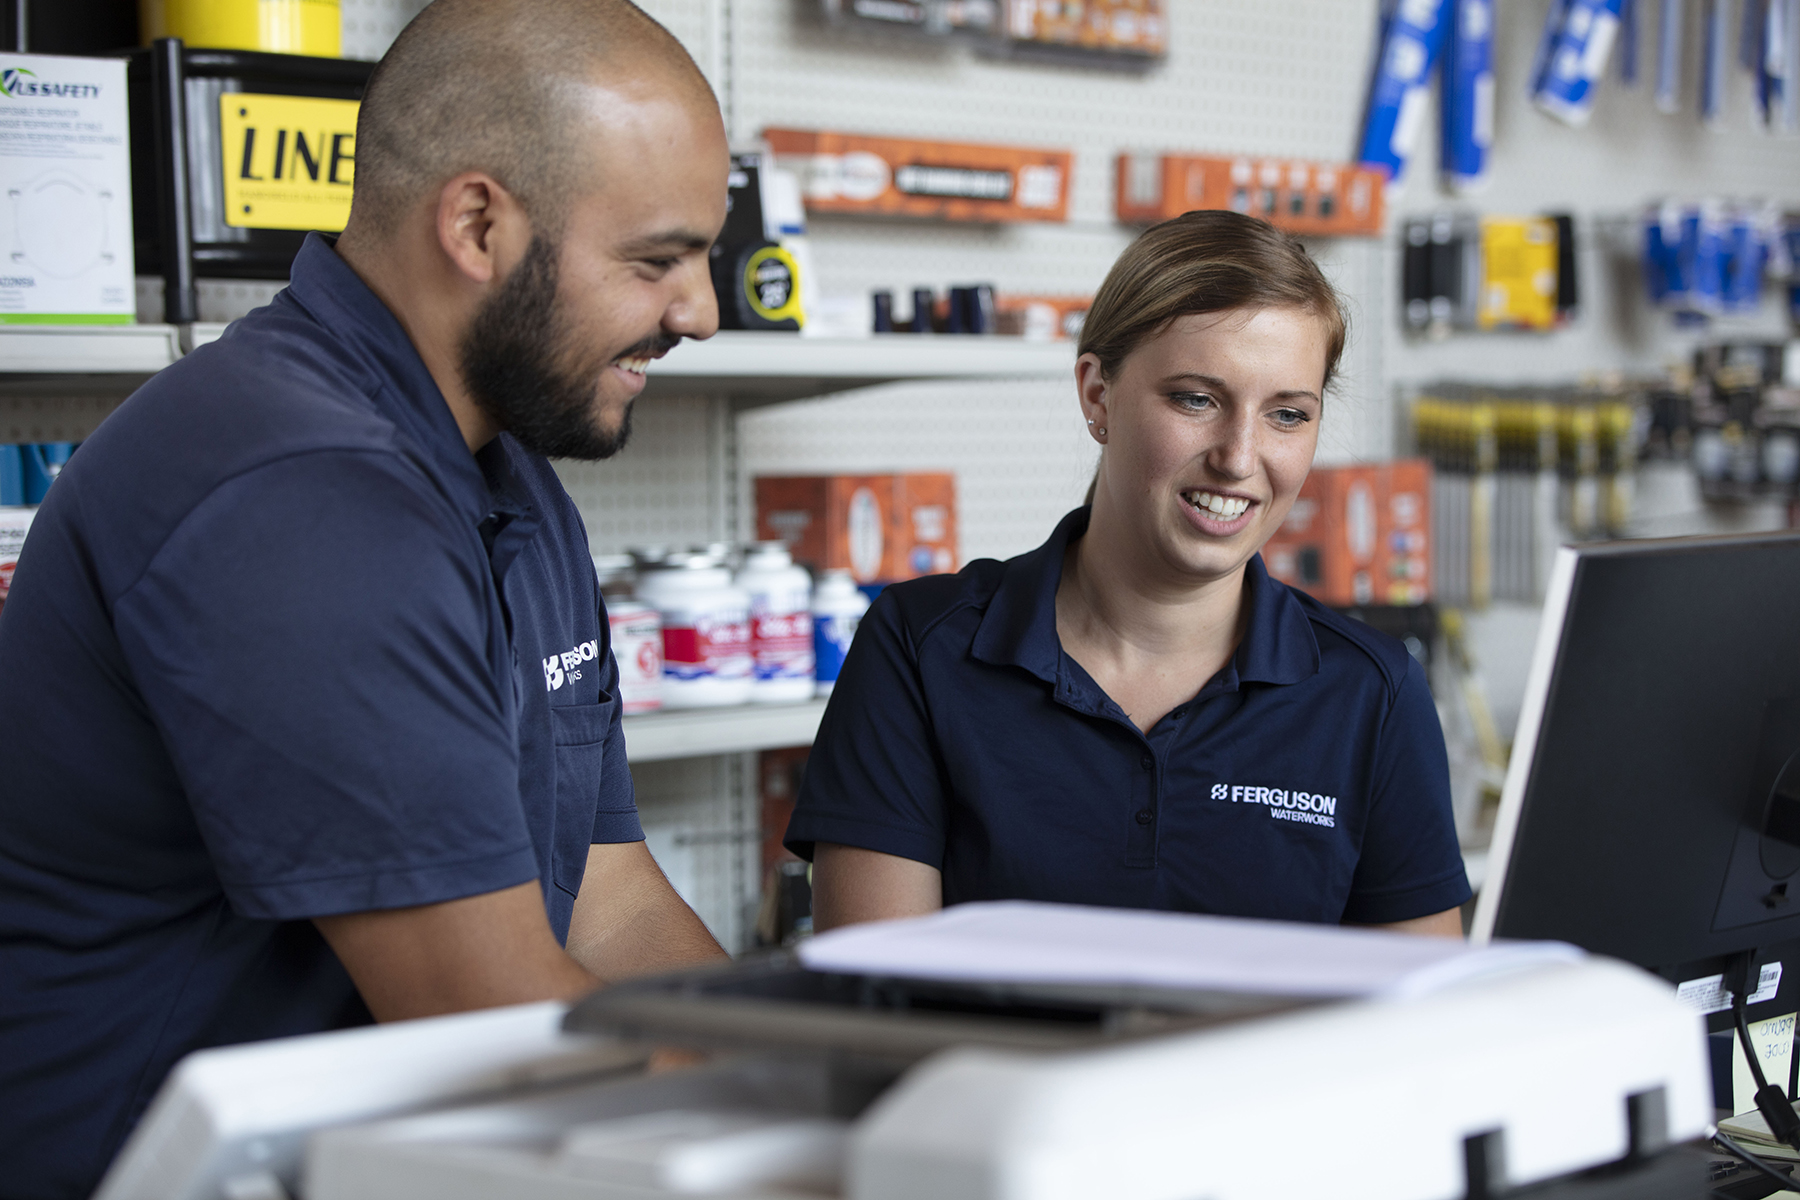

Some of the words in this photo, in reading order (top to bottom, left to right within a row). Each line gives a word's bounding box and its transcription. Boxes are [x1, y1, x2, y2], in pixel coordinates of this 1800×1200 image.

[40, 83, 101, 99] SAFETY
[240, 127, 355, 186] LINE
[1231, 785, 1337, 816] FERGUSON
[1270, 807, 1336, 828] WATERWORKS
